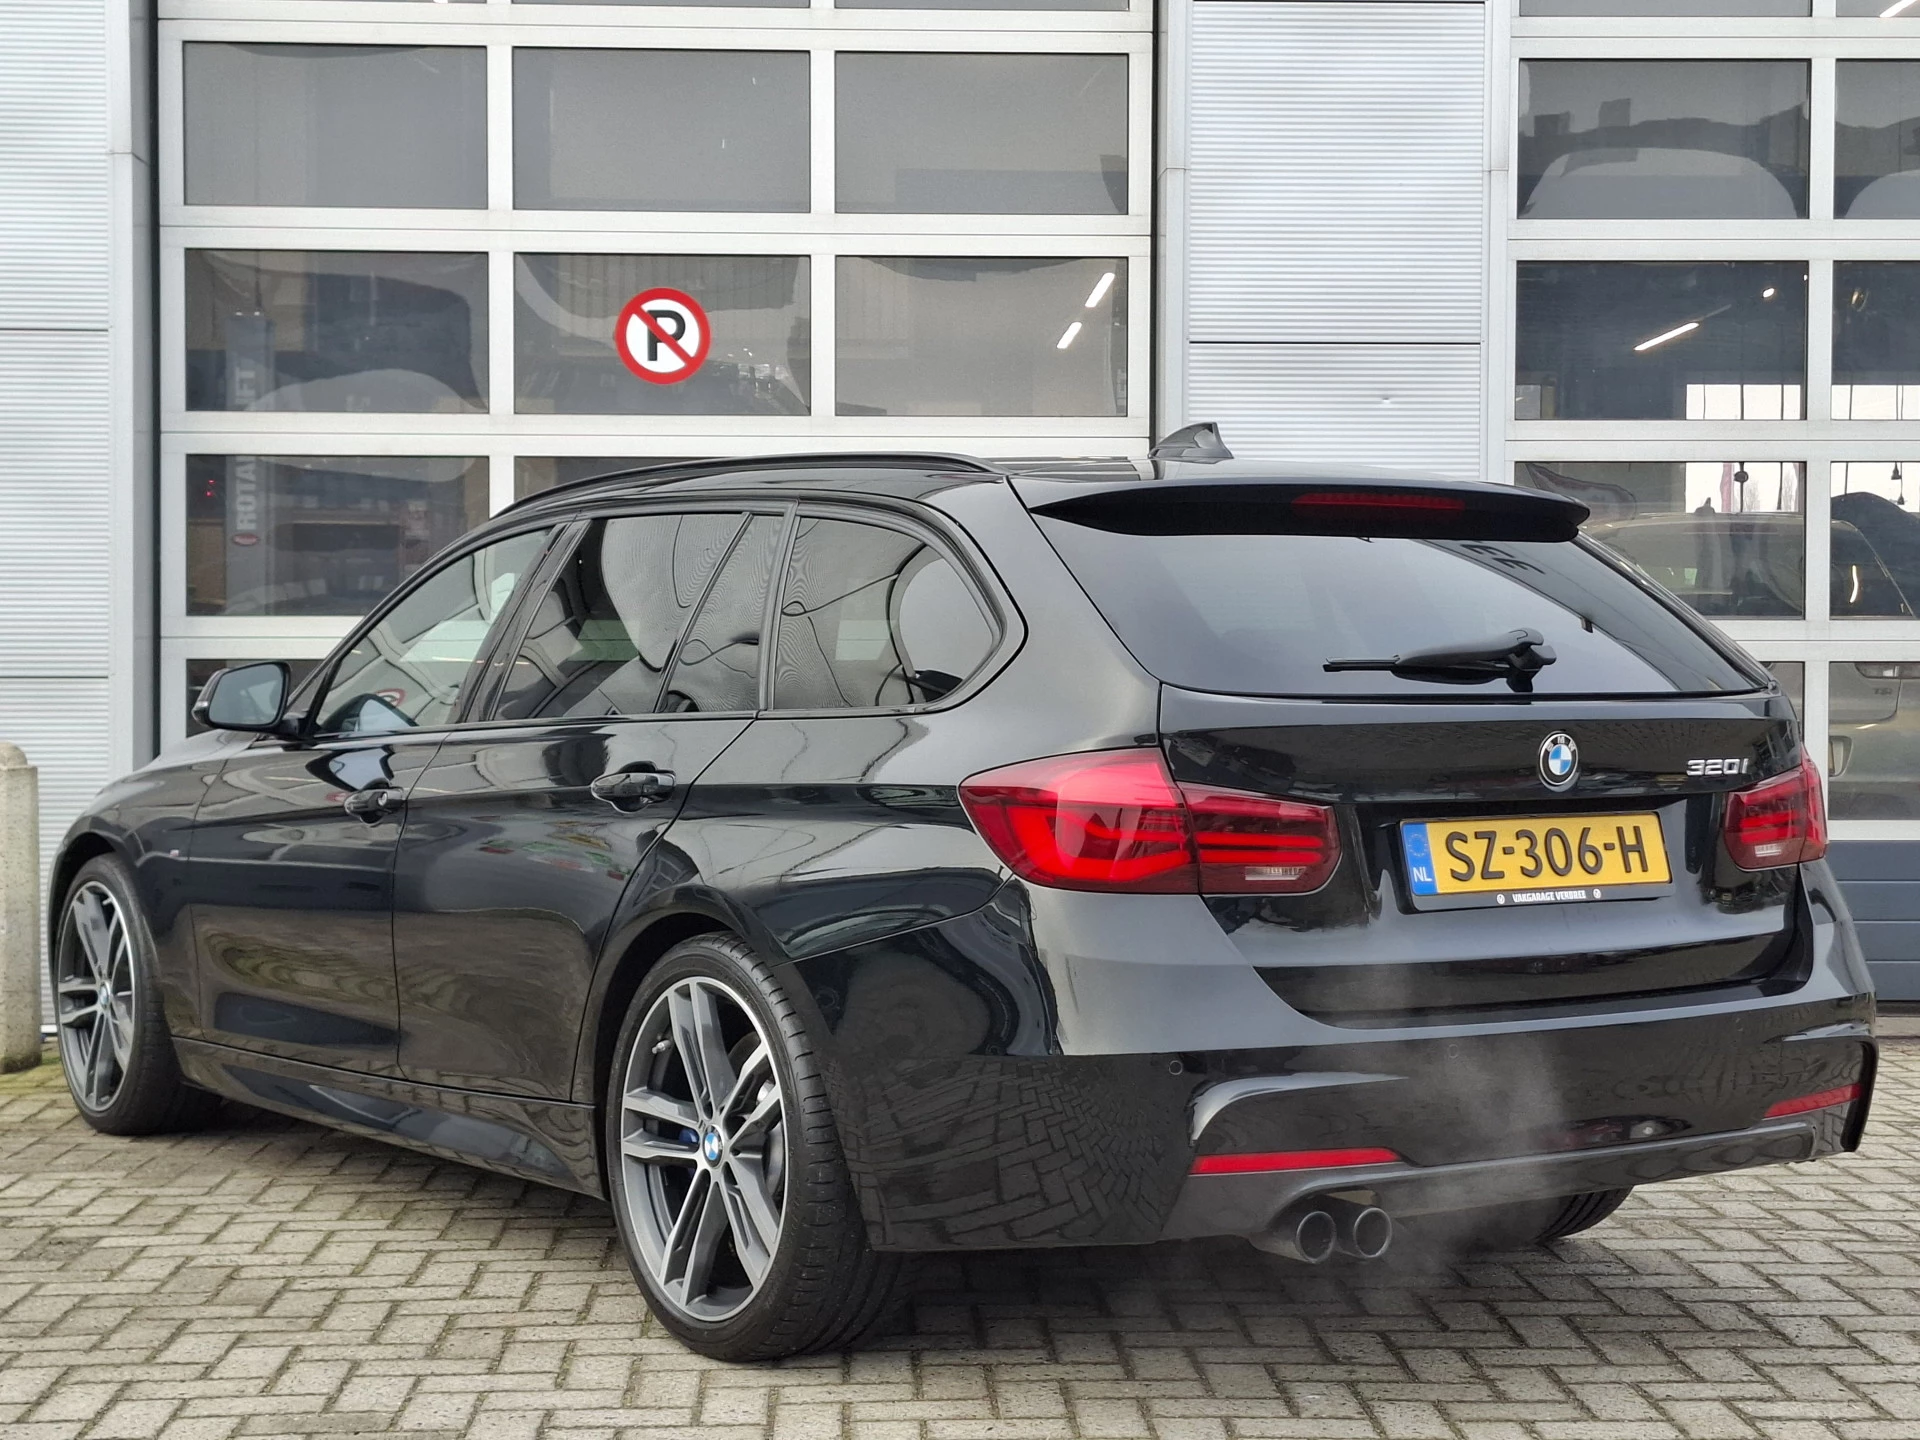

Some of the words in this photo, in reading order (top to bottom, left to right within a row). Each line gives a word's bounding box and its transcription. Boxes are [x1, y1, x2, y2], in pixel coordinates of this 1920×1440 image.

[647, 310, 686, 361] P
[1545, 735, 1576, 752] BMW
[1445, 825, 1648, 881] SZ-306-H
[1413, 866, 1432, 882] NL
